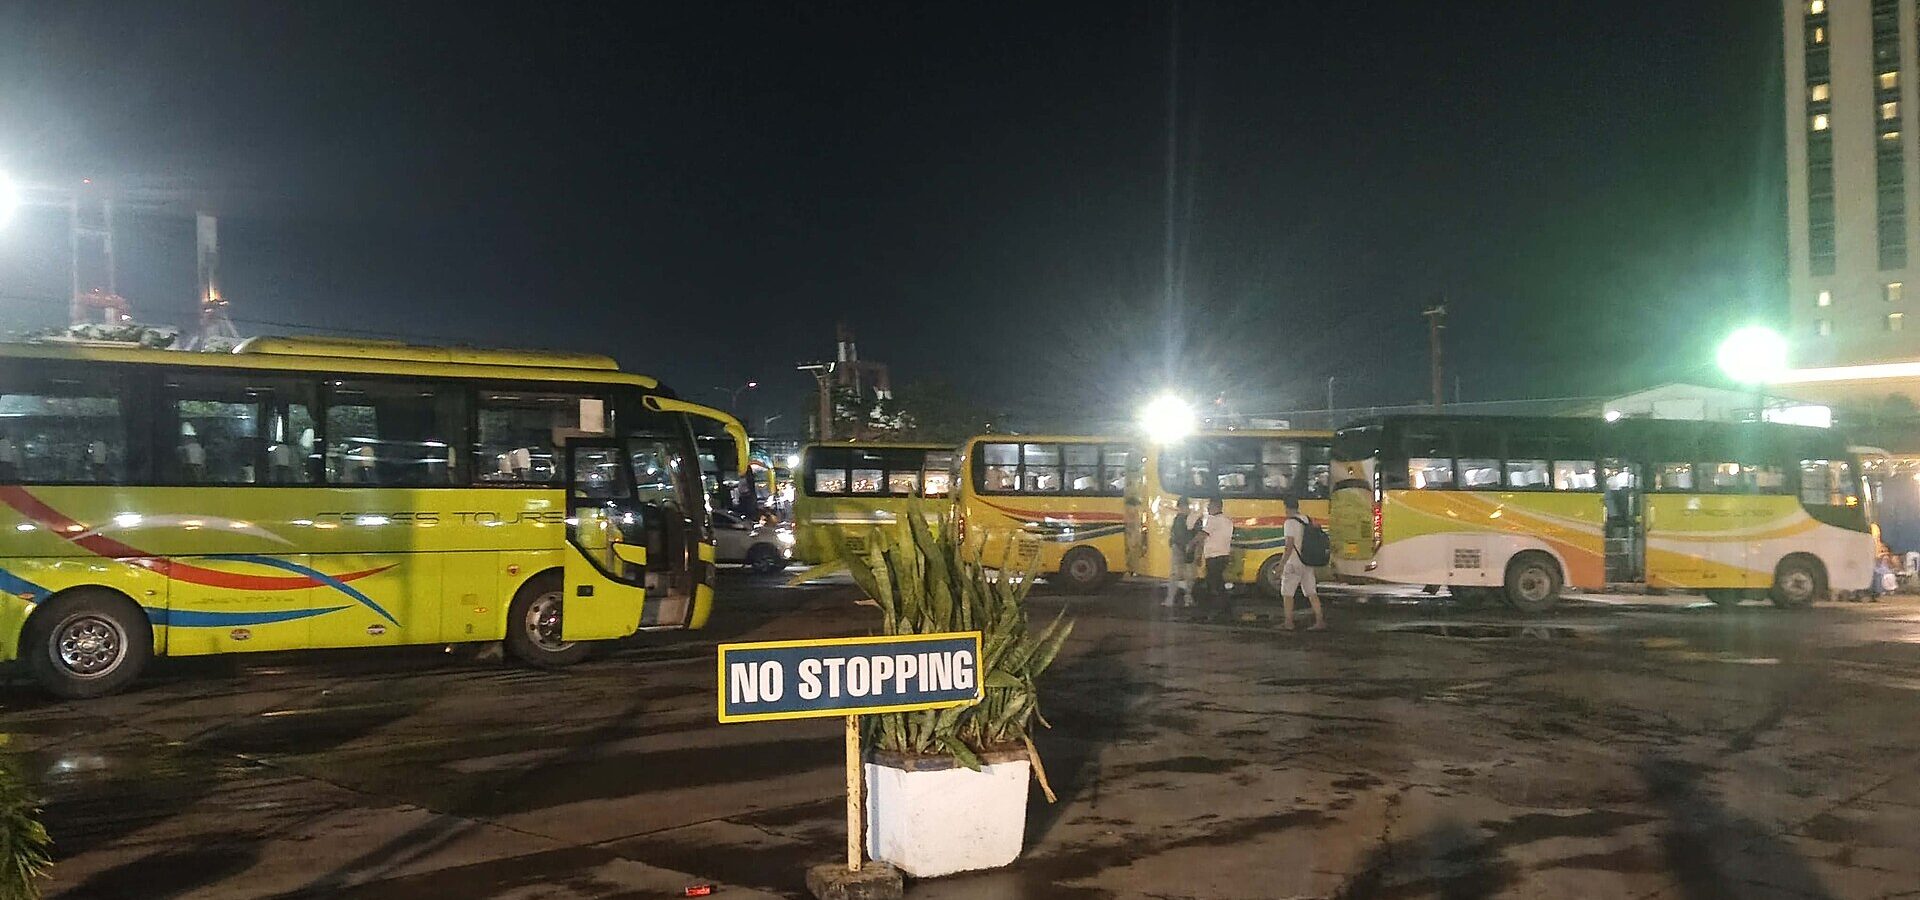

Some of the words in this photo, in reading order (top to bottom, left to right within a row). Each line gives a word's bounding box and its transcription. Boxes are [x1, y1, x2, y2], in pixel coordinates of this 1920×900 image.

[452, 511, 564, 525] TOURS
[731, 661, 784, 704] NO
[798, 650, 974, 700] STOPPING
